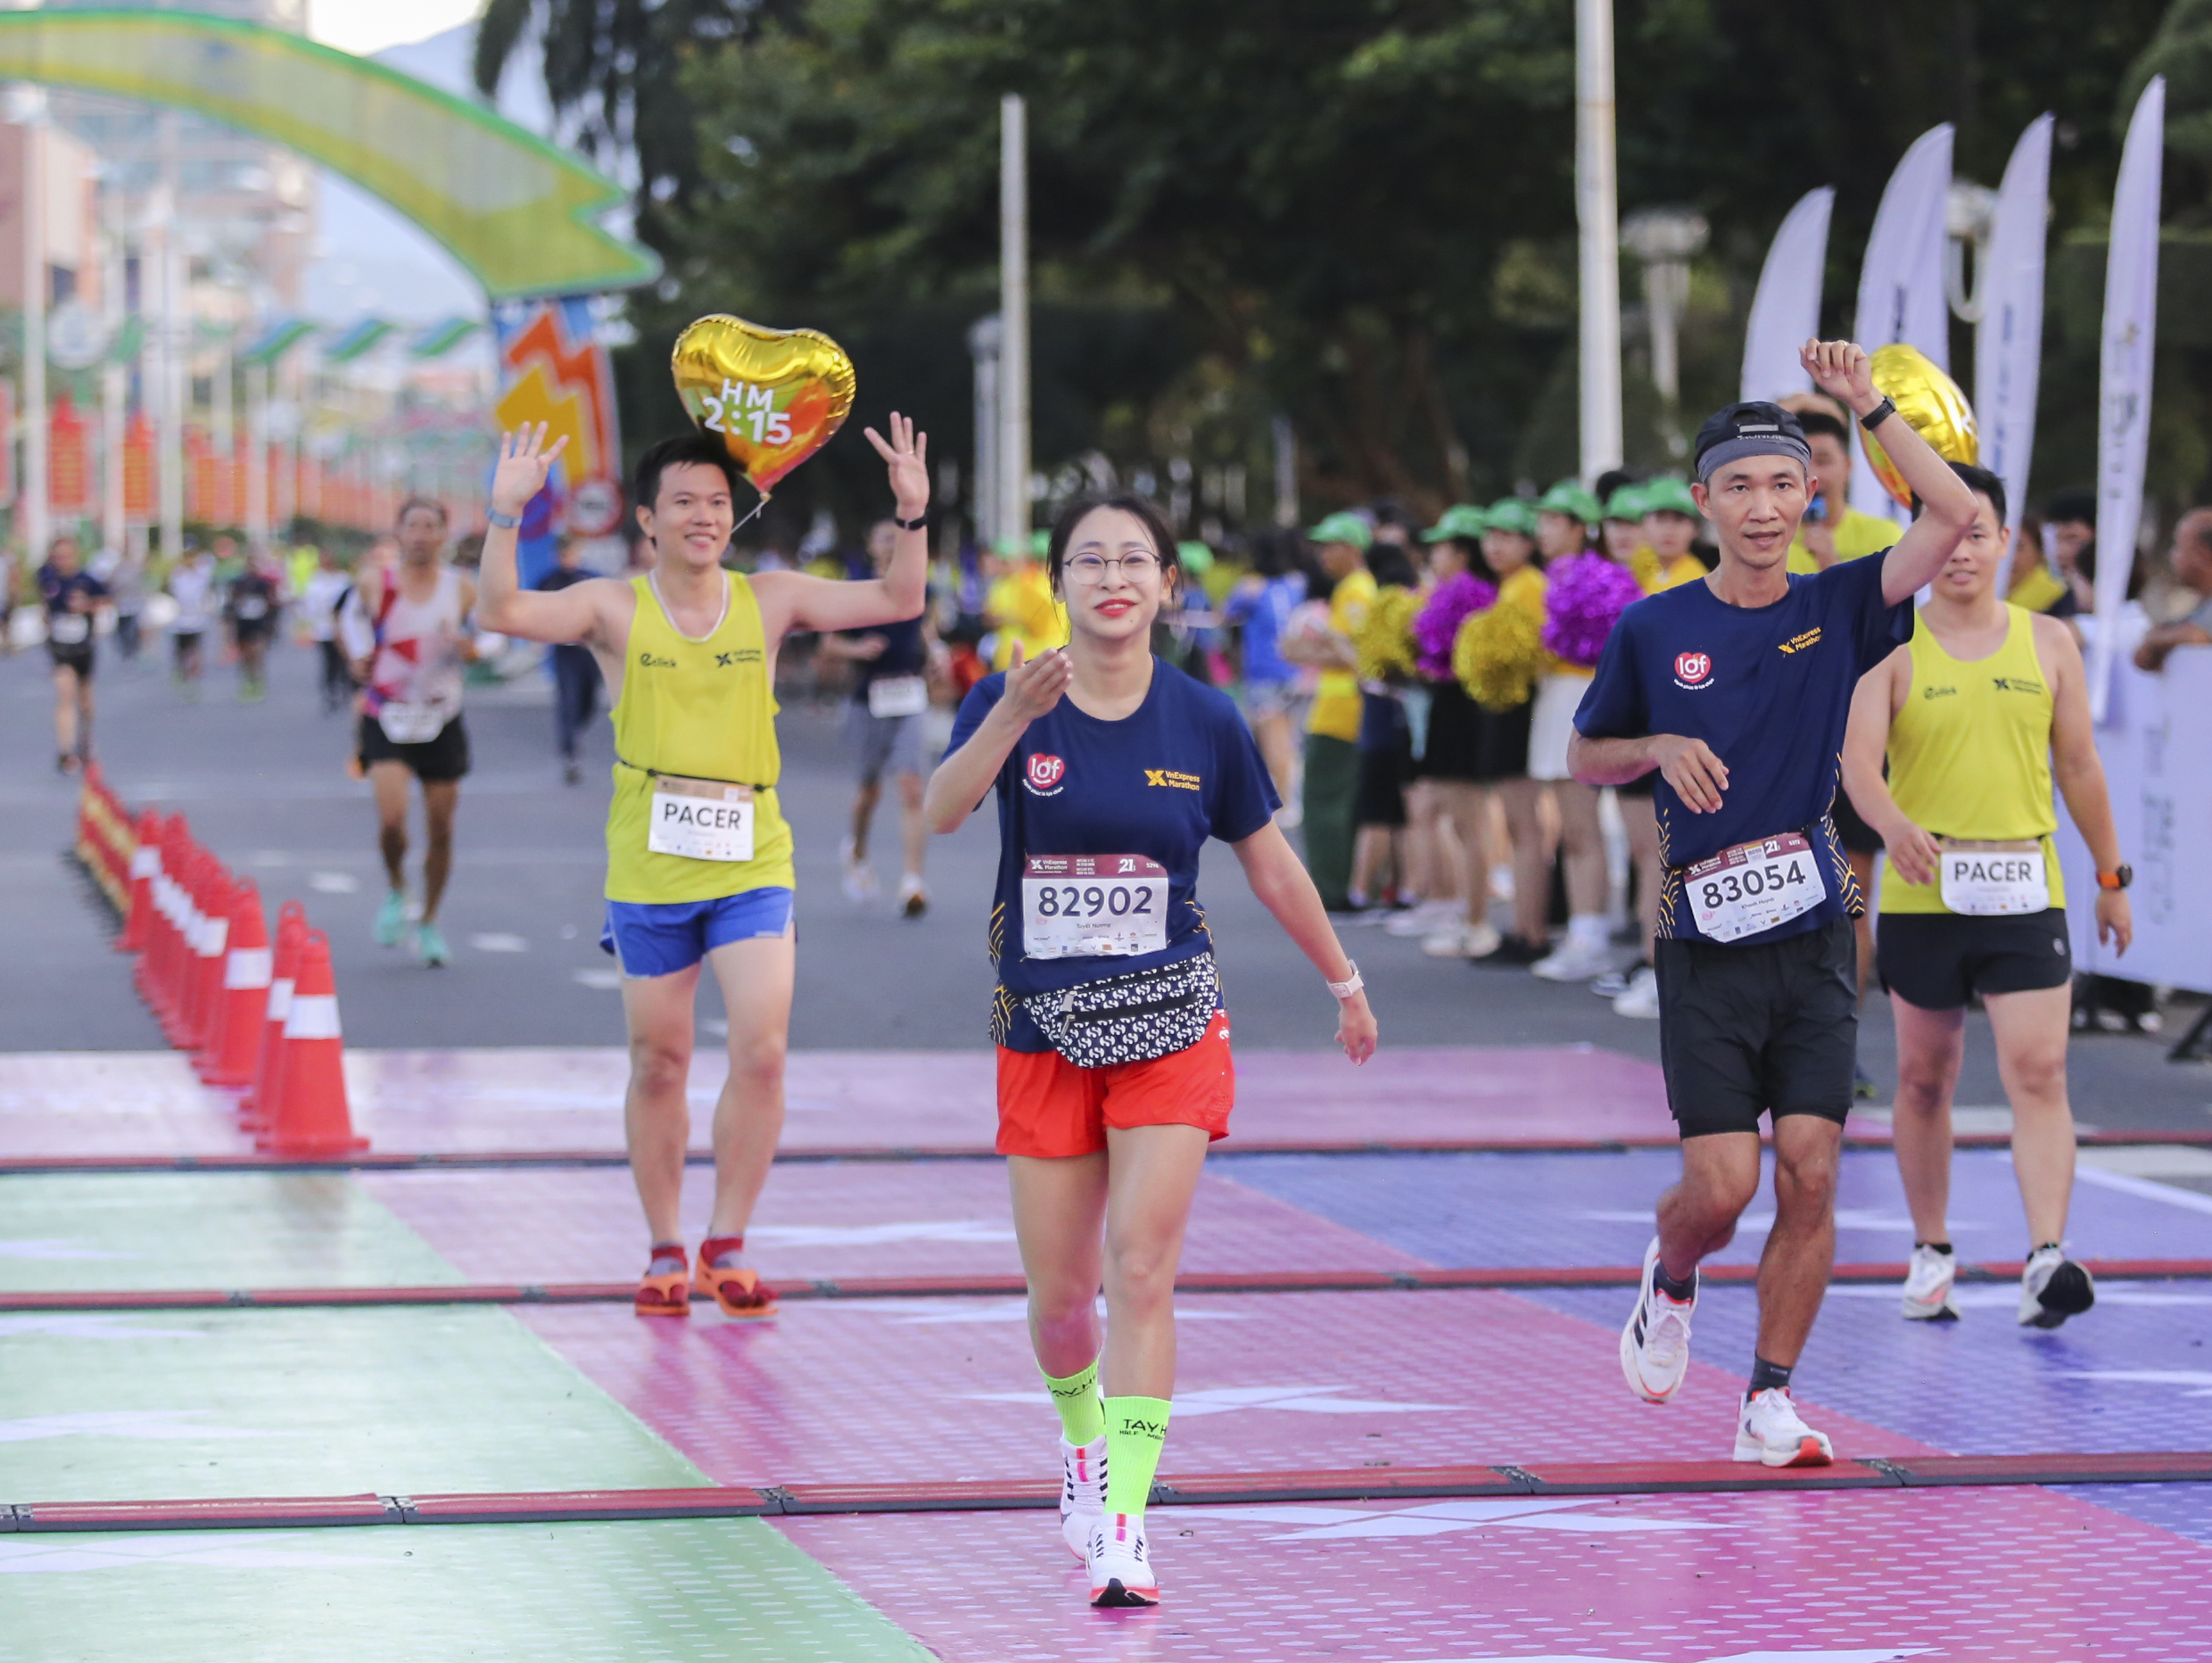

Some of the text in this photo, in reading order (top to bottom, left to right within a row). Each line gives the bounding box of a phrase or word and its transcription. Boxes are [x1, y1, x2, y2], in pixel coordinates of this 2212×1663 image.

[721, 377, 774, 413] HM
[702, 396, 792, 444] 2:15
[1790, 626, 1821, 644] VnExpress
[1165, 770, 1200, 782] VnExpress
[1168, 779, 1200, 790] Marathon
[664, 803, 741, 830] PACER
[1954, 861, 2032, 881] PACER
[1702, 860, 1806, 909] 83054
[1038, 886, 1153, 917] 82902
[1123, 1419, 1160, 1433] TAY
